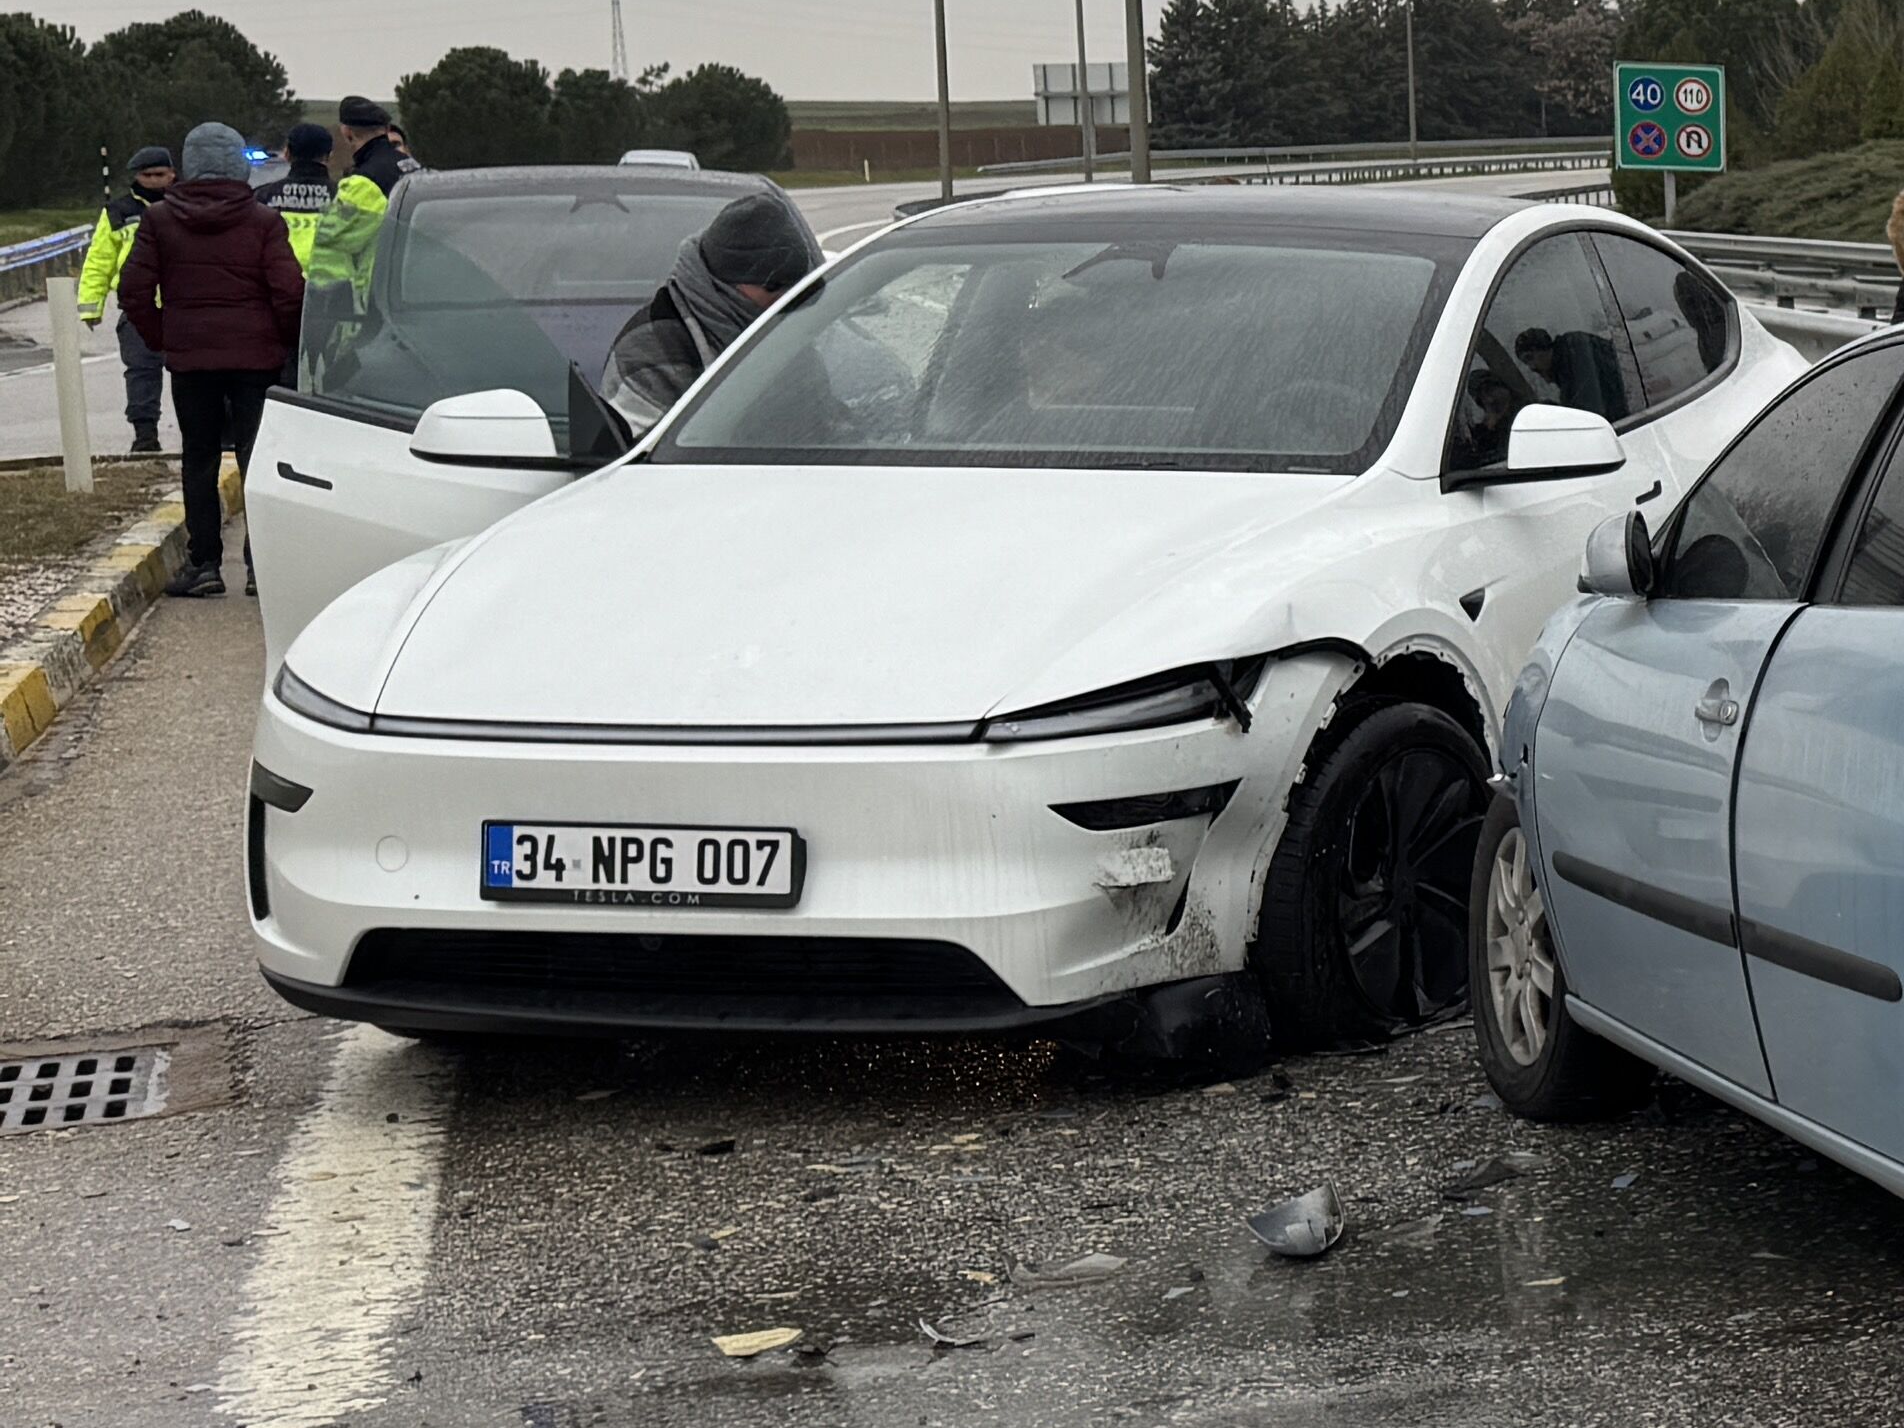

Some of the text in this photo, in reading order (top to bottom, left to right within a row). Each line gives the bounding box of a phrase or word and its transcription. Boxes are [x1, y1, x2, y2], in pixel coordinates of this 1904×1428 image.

[1631, 83, 1704, 106] 40 110
[490, 860, 511, 875] TR
[515, 833, 781, 887] 34 NPG 007
[572, 890, 701, 906] TESLA.COM
